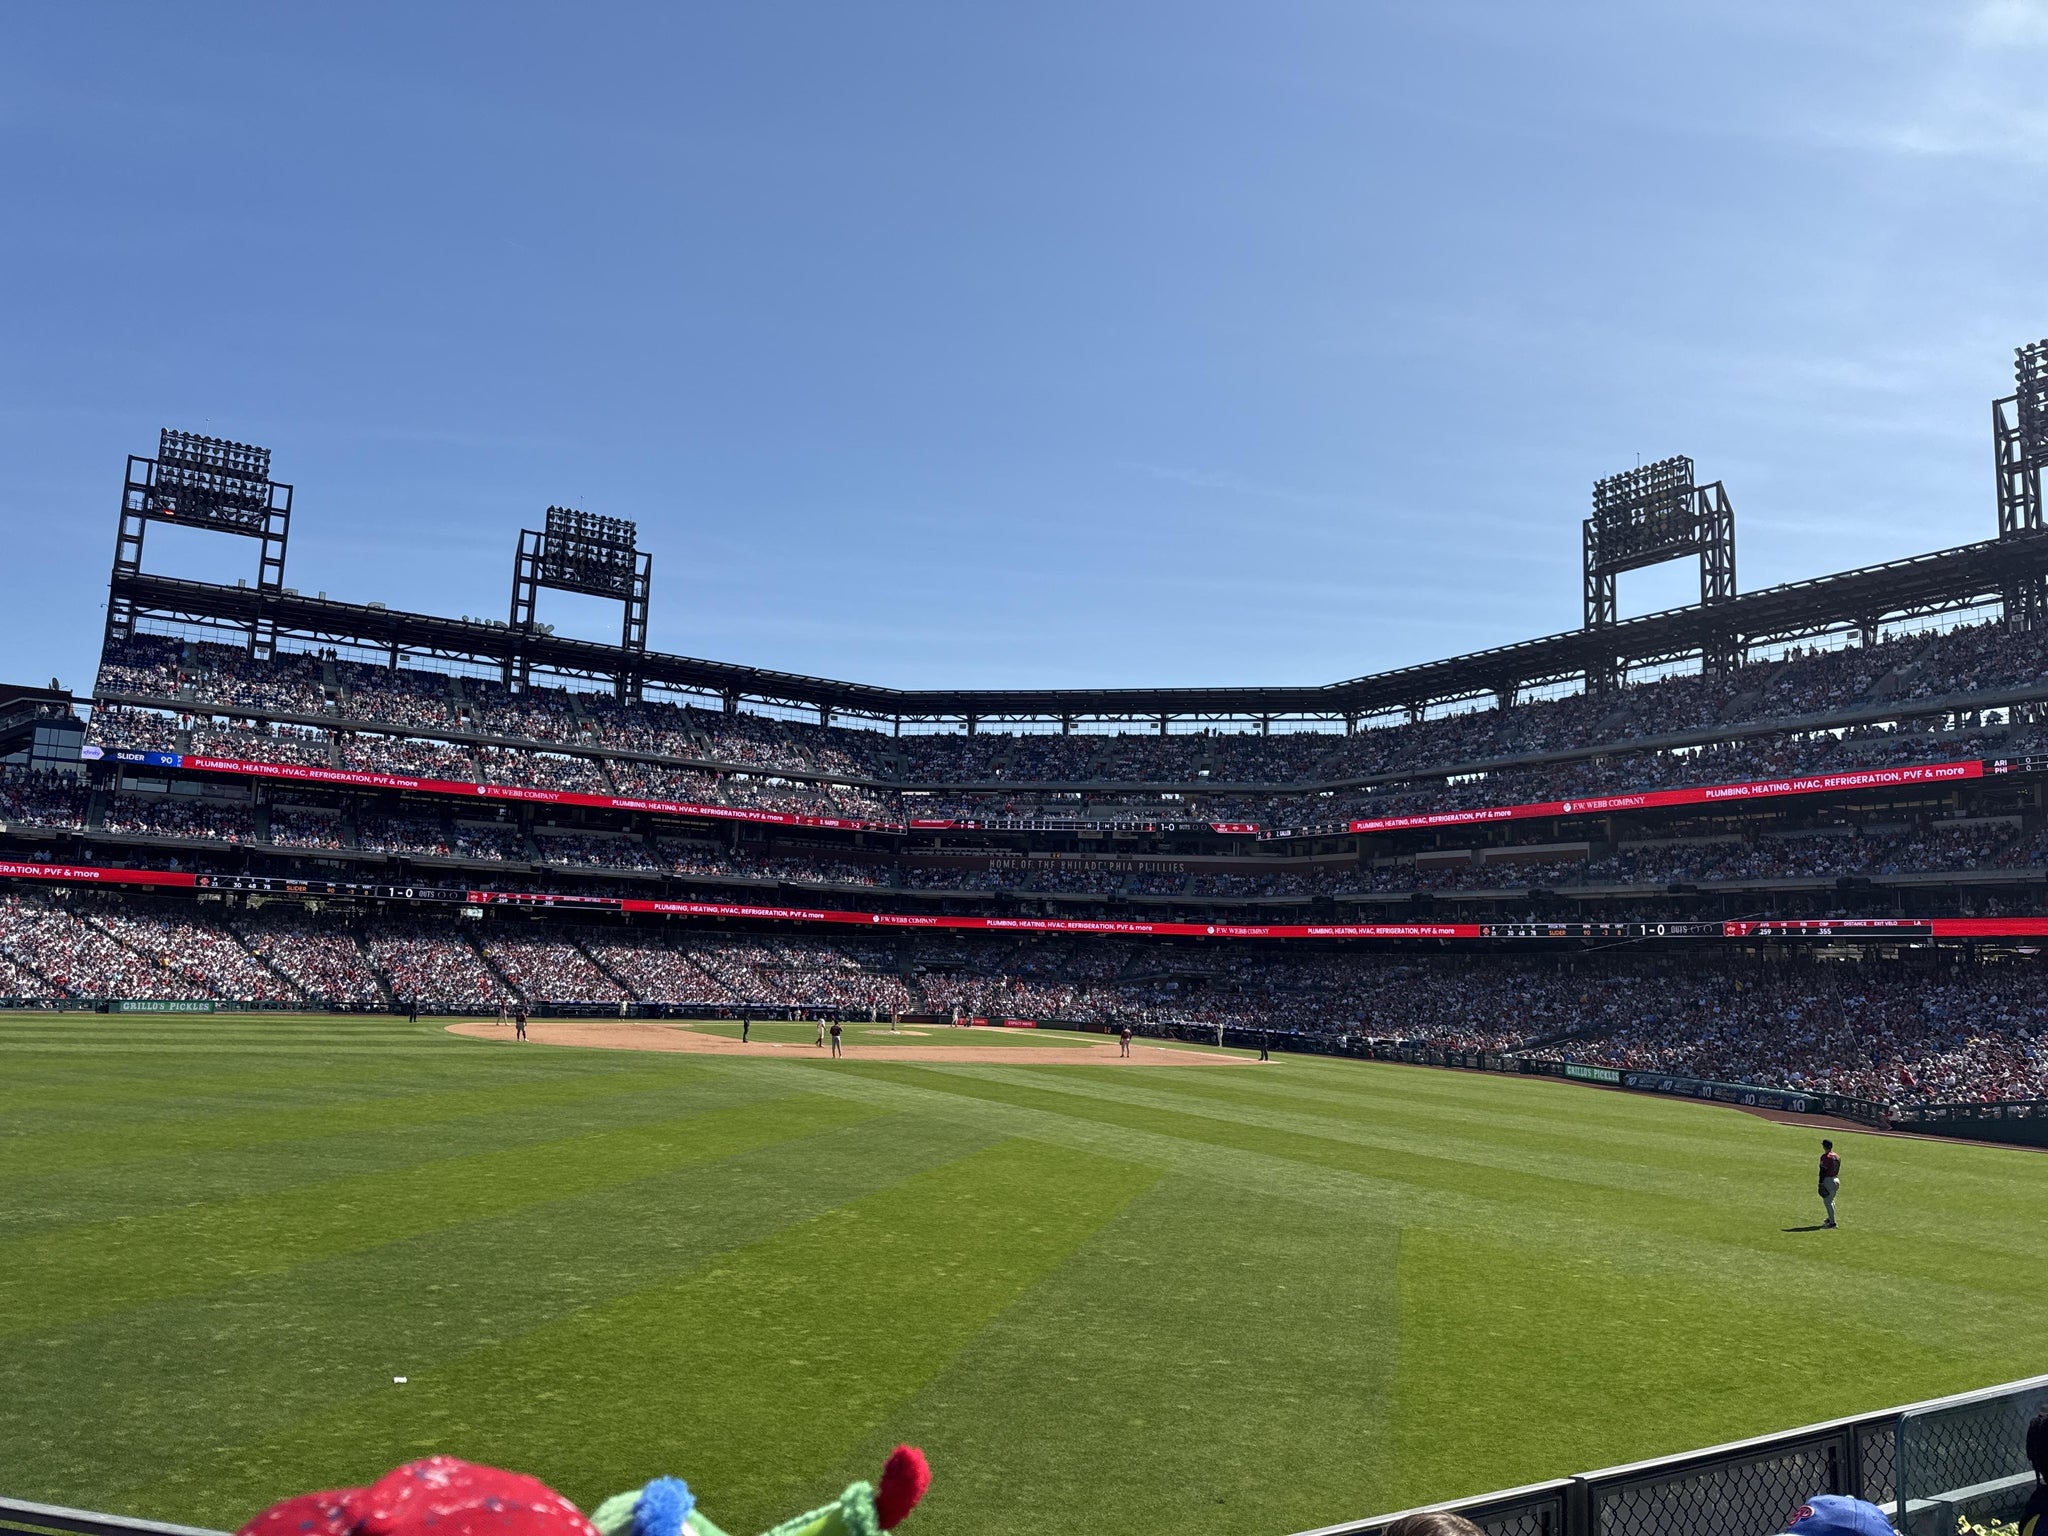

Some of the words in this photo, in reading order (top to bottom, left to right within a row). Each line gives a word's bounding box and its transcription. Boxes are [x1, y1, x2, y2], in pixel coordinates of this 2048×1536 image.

[117, 752, 145, 762] SLIDER
[160, 756, 172, 764] 90
[195, 759, 241, 771] PLUMBING,
[243, 764, 280, 775] HEATING,
[282, 768, 308, 778] HVAC,
[310, 771, 372, 784] REFRIGERATION,
[1994, 766, 2008, 774] PHI
[1706, 788, 1750, 798] PLUMBING,
[1752, 783, 1792, 794] HEATING,
[1794, 780, 1823, 790] HVAC,
[1824, 772, 1902, 787] REFRIGERATION,
[1903, 770, 1922, 780] PVF
[1924, 768, 1933, 778] &
[1936, 766, 1965, 776] more
[502, 789, 523, 797] WEBB
[524, 792, 560, 800] COMPANY
[1586, 801, 1608, 809] WEBB
[1608, 796, 1646, 807] COMPANY
[612, 799, 648, 809] PLUMBING,
[648, 802, 678, 812] HEATING,
[679, 806, 700, 814] HVAC,
[700, 807, 748, 819] REFRIGERATION,
[750, 812, 760, 820] PVF
[767, 814, 783, 822] more
[1356, 822, 1384, 830] PLUMBING,
[1385, 819, 1410, 828] HEATING,
[1429, 813, 1474, 824] REFRIGERATION,
[1494, 810, 1512, 818] more
[1161, 823, 1175, 831] 1-0
[990, 860, 1016, 869] HOME
[44, 868, 62, 876] PVF
[654, 903, 689, 912] PLUMBING,
[690, 905, 719, 914] HEATING,
[720, 907, 740, 915] HVAC,
[741, 908, 788, 918] REFRIGERATION,
[987, 919, 1018, 927] PLUMBING,
[1068, 922, 1115, 930] REFRIGERATION,
[1670, 926, 1688, 934] OUTS
[123, 1002, 165, 1010] GRILLO'S
[170, 1002, 209, 1011] PICKLES
[1566, 1066, 1591, 1077] GRILLO'S
[1594, 1069, 1619, 1080] PICKLES
[1663, 1080, 1672, 1090] 10
[1702, 1086, 1711, 1098] 10
[1745, 1094, 1755, 1105] 10
[1792, 1099, 1805, 1112] 10
